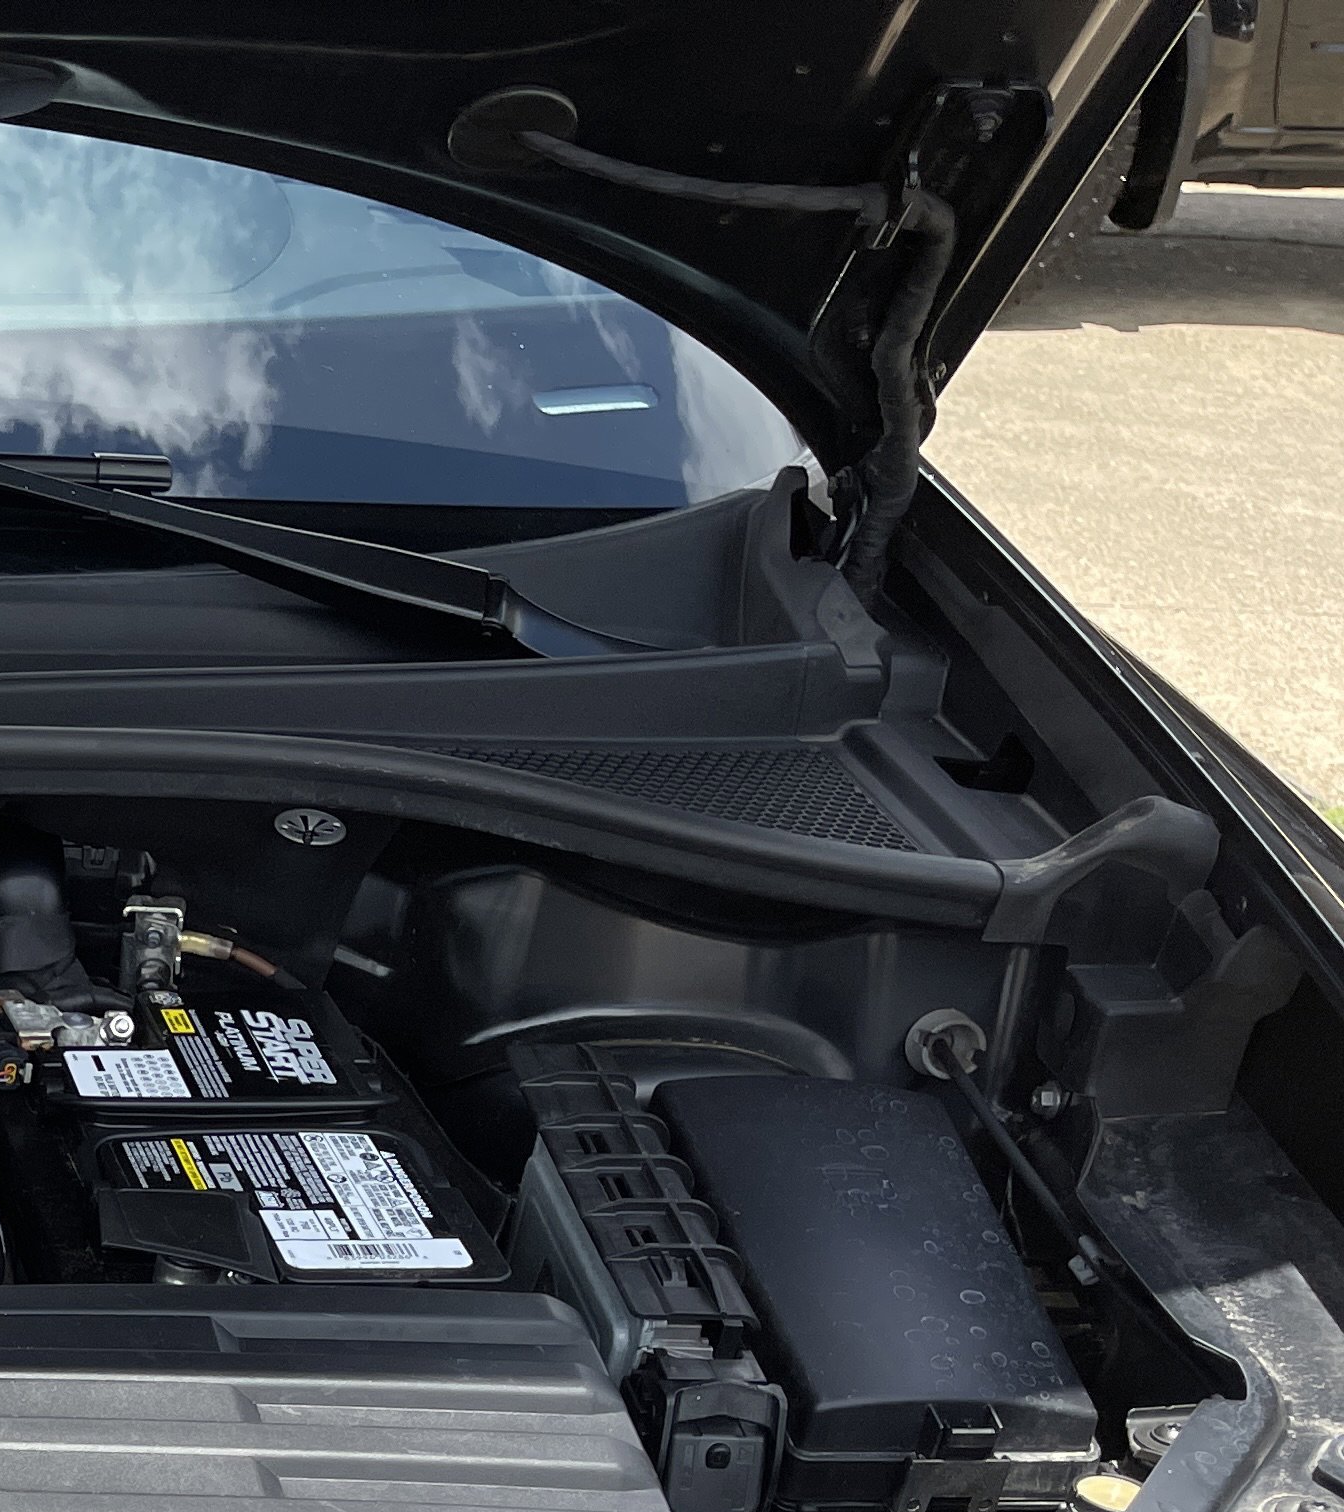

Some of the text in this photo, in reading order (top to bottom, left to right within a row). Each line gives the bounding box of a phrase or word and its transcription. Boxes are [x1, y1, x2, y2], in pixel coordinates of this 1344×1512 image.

[214, 1011, 262, 1072] PLATINUM
[240, 1009, 311, 1085] START
[279, 1018, 338, 1084] SUPER
